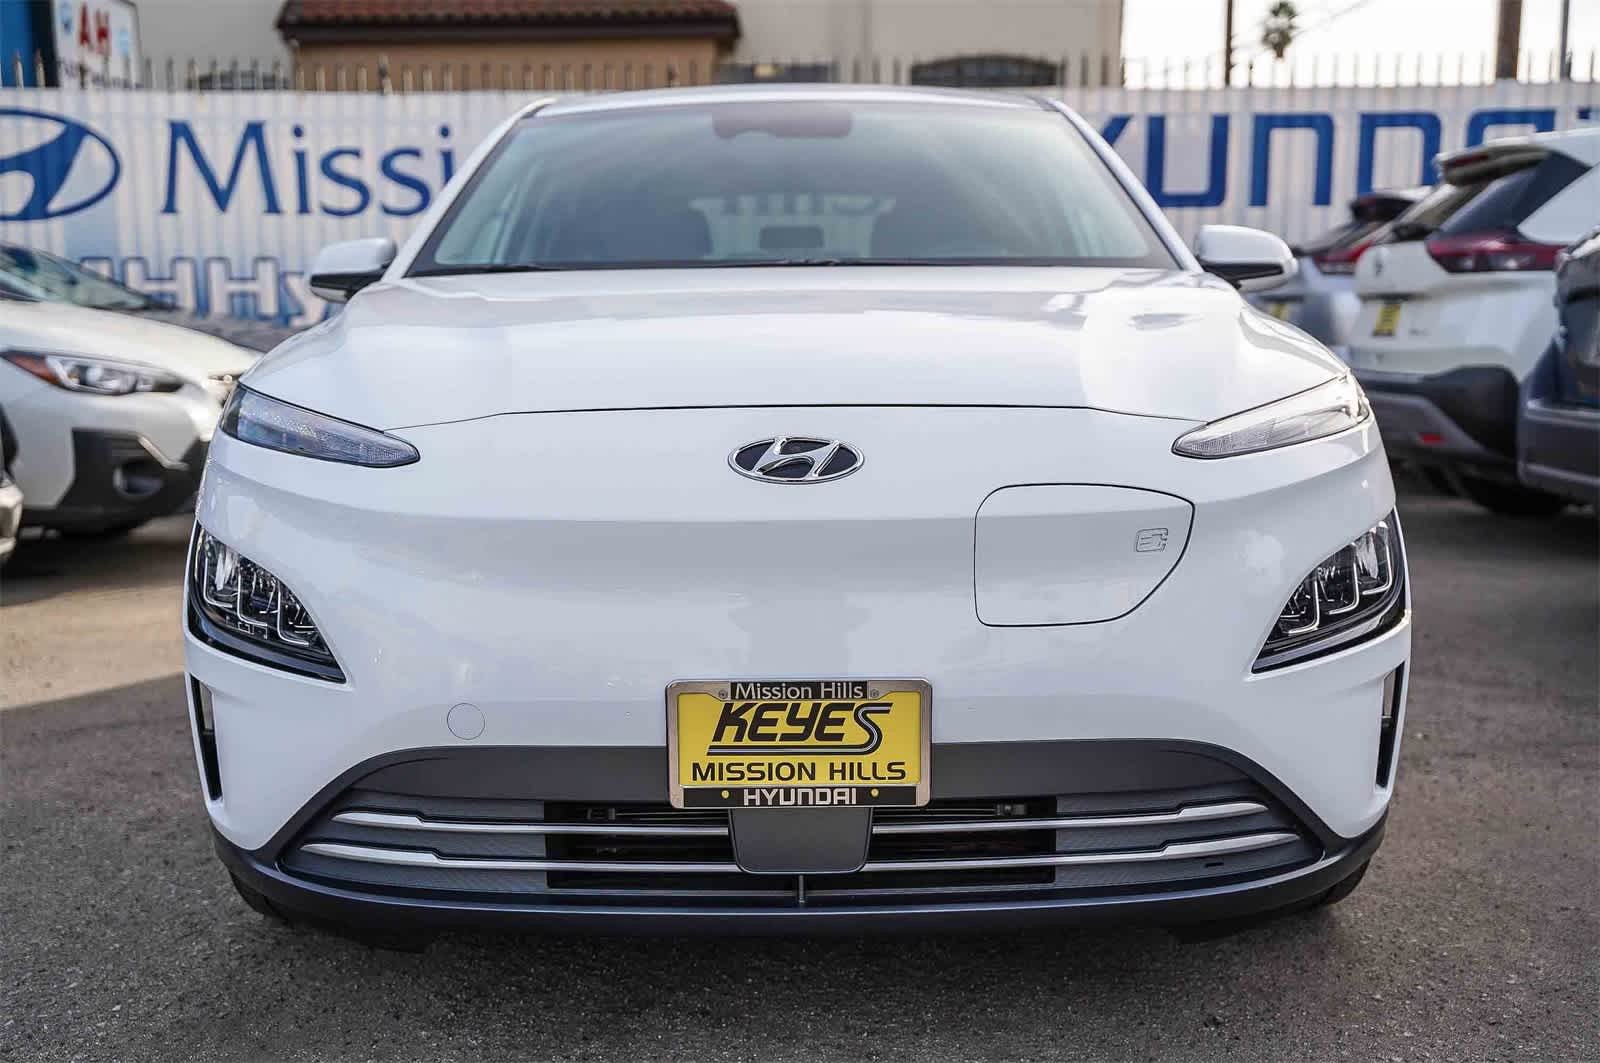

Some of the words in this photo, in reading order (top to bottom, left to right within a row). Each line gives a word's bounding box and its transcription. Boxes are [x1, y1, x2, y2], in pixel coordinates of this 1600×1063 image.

[735, 682, 812, 699] Mission
[820, 682, 864, 699] Hills
[707, 702, 893, 755] KEYES
[692, 762, 816, 781] MISSION
[829, 761, 906, 780] HILLS
[743, 787, 857, 805] HYUNDAI
